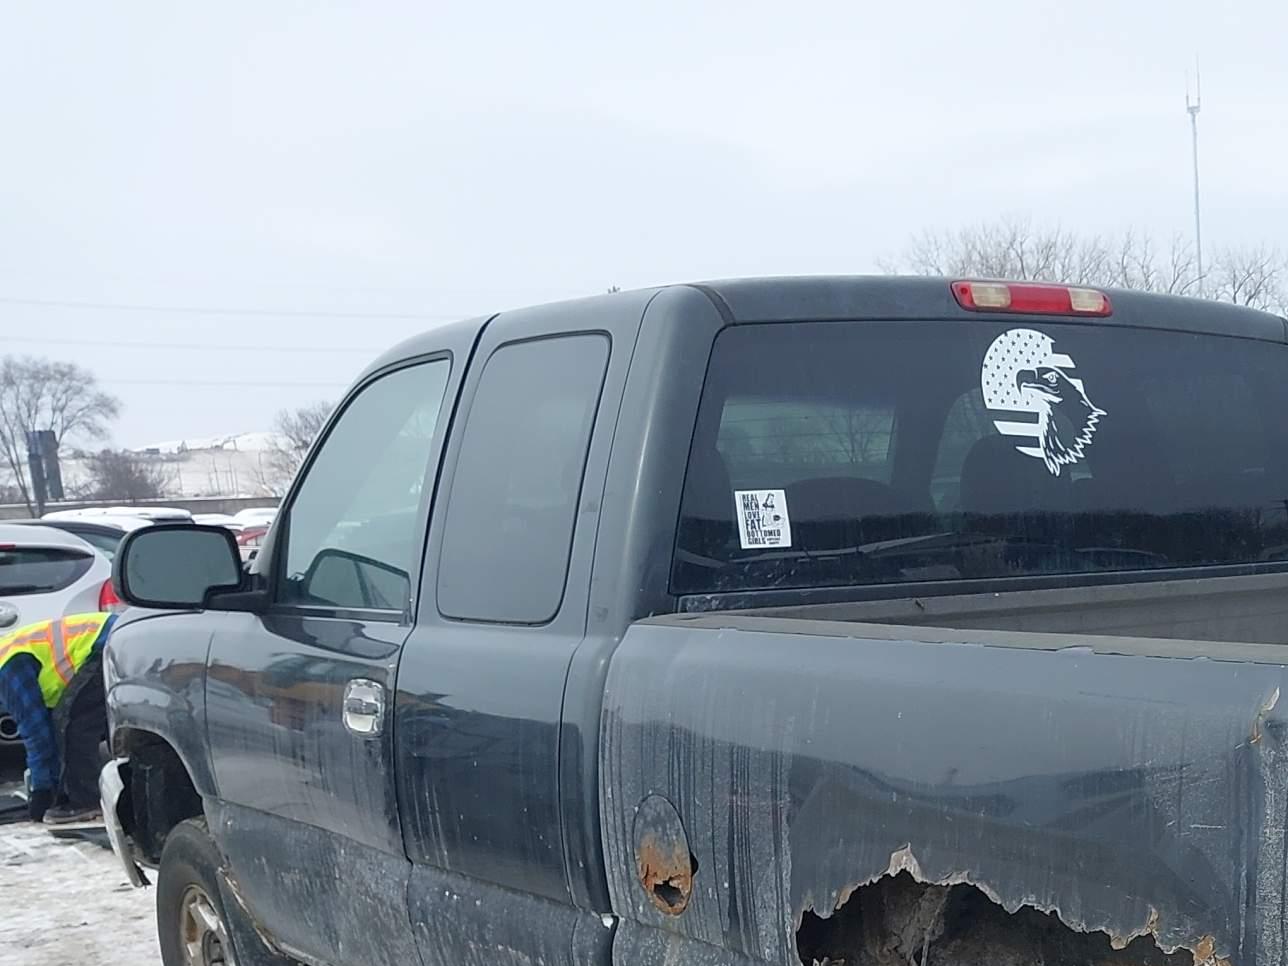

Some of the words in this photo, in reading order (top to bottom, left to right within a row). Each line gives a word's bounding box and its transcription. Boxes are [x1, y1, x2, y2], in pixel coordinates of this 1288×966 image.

[743, 501, 760, 511] MEN
[745, 511, 760, 520] LOVE
[746, 518, 761, 531] FAT
[747, 529, 781, 538] BOTTOMED
